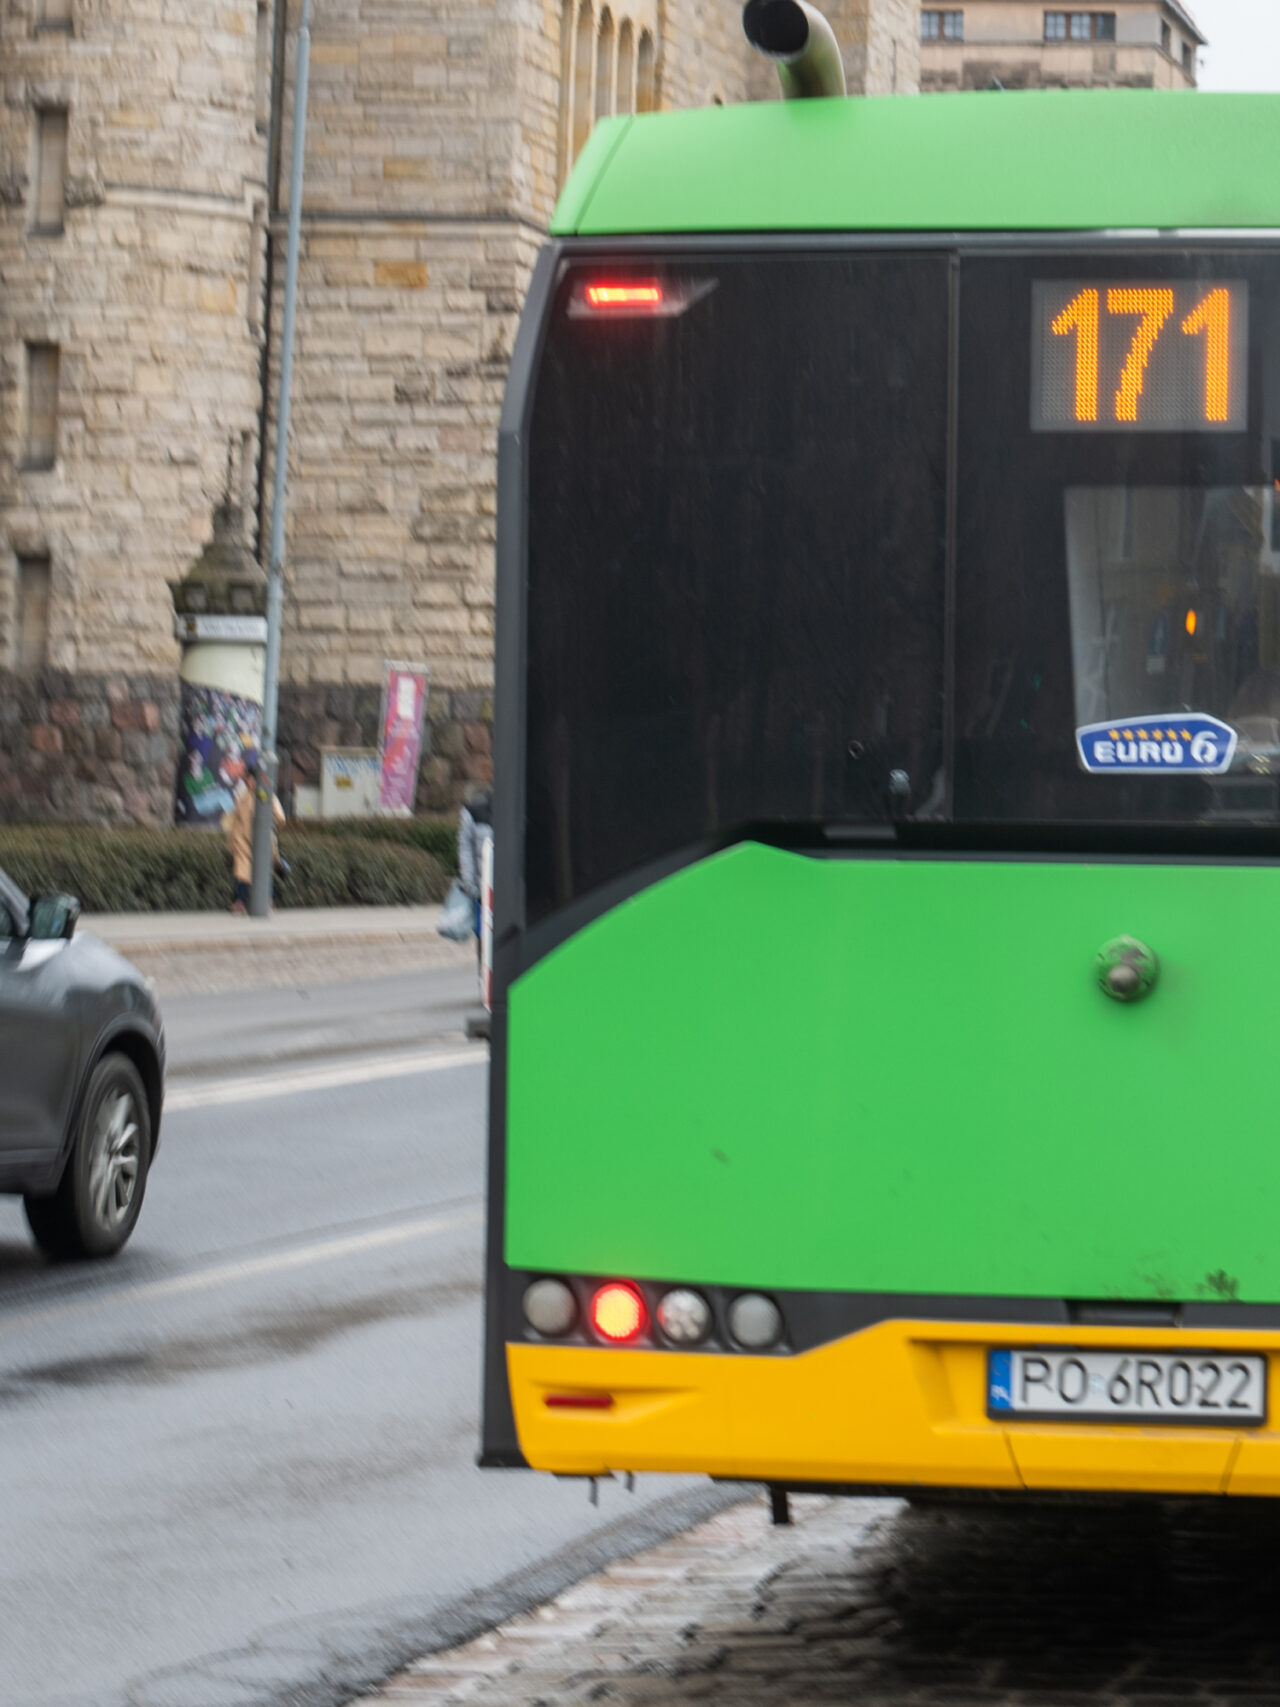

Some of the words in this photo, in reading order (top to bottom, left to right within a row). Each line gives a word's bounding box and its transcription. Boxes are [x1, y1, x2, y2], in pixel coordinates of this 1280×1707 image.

[1051, 287, 1229, 422] 171
[1094, 741, 1184, 763] EURO
[1190, 730, 1218, 763] 6
[1022, 1357, 1087, 1404] PO
[1108, 1359, 1252, 1409] 6R022
